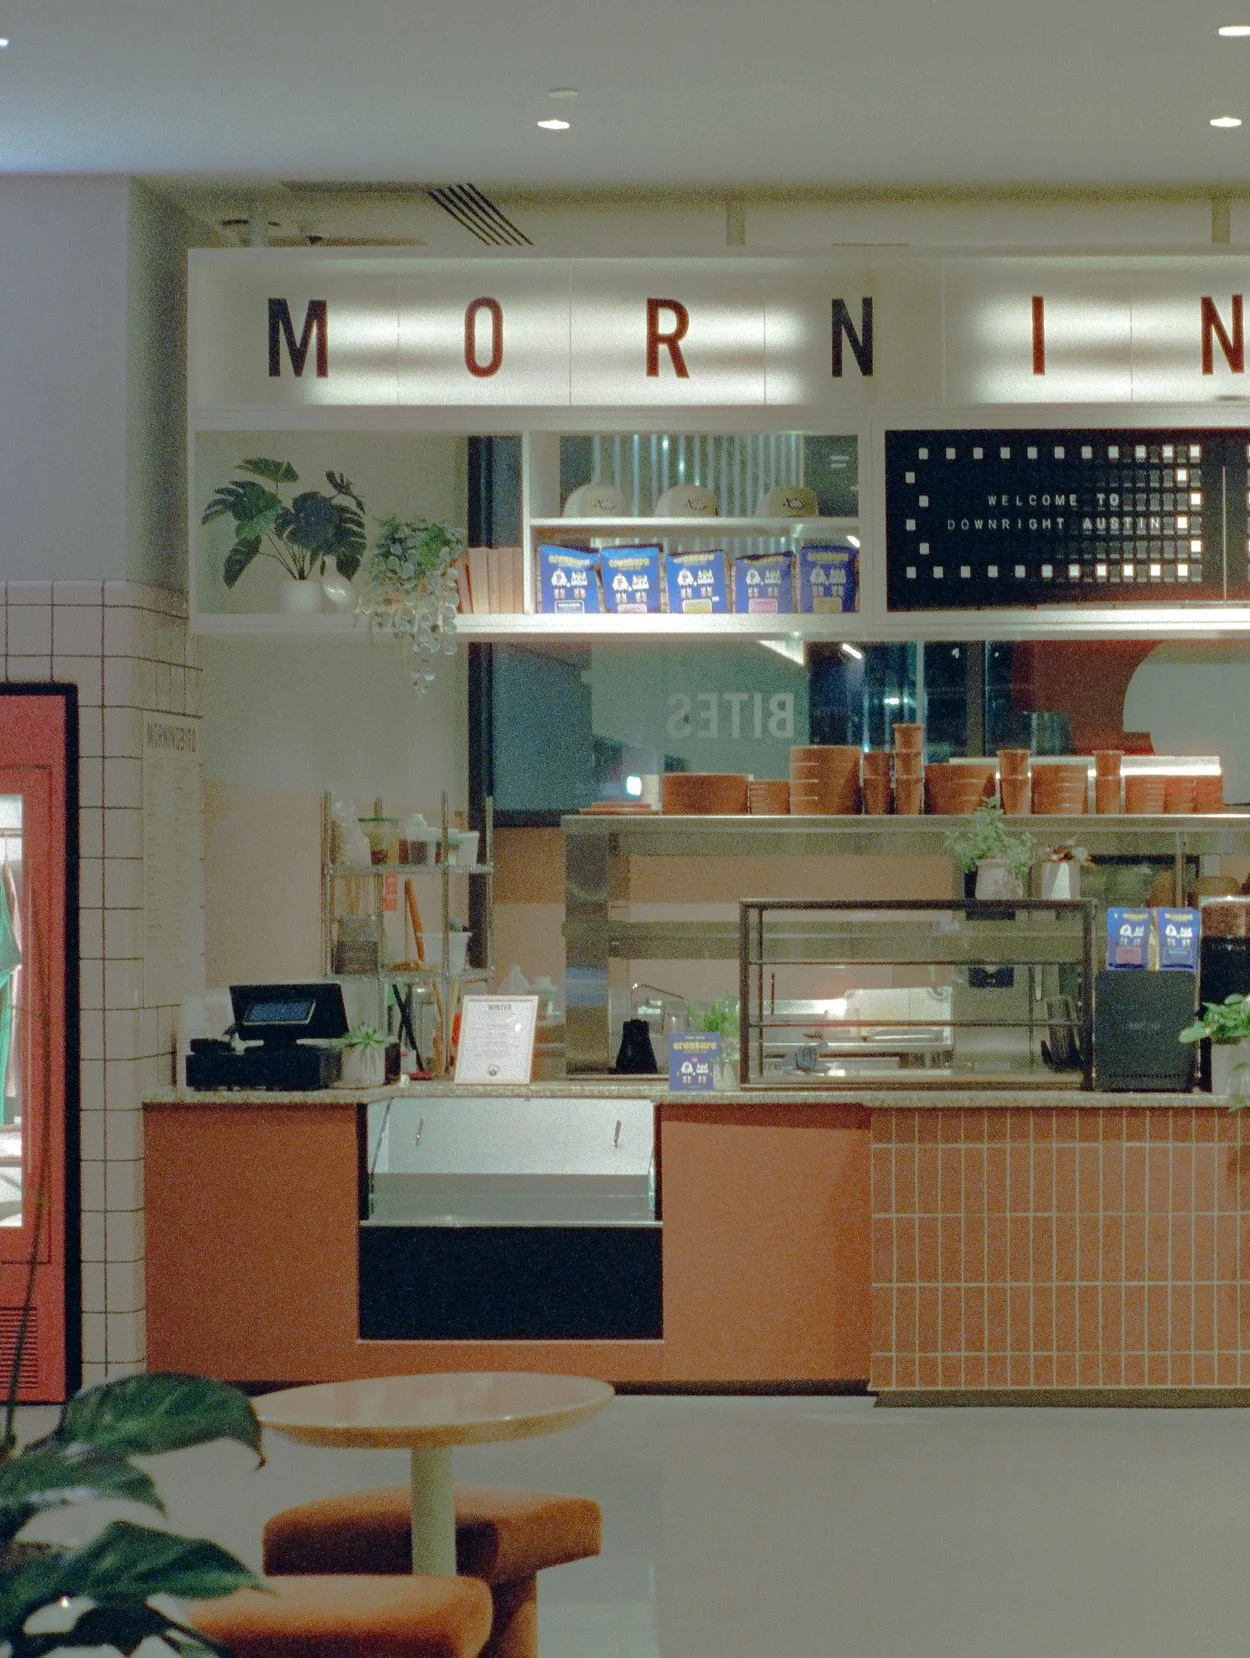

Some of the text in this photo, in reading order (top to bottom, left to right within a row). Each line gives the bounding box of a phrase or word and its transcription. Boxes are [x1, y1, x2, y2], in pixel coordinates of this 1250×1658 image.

[988, 493, 1119, 506] WELCOME TO
[947, 517, 1160, 530] DOWNRIGHT AUSTIN
[488, 1003, 512, 1011] WINTER
